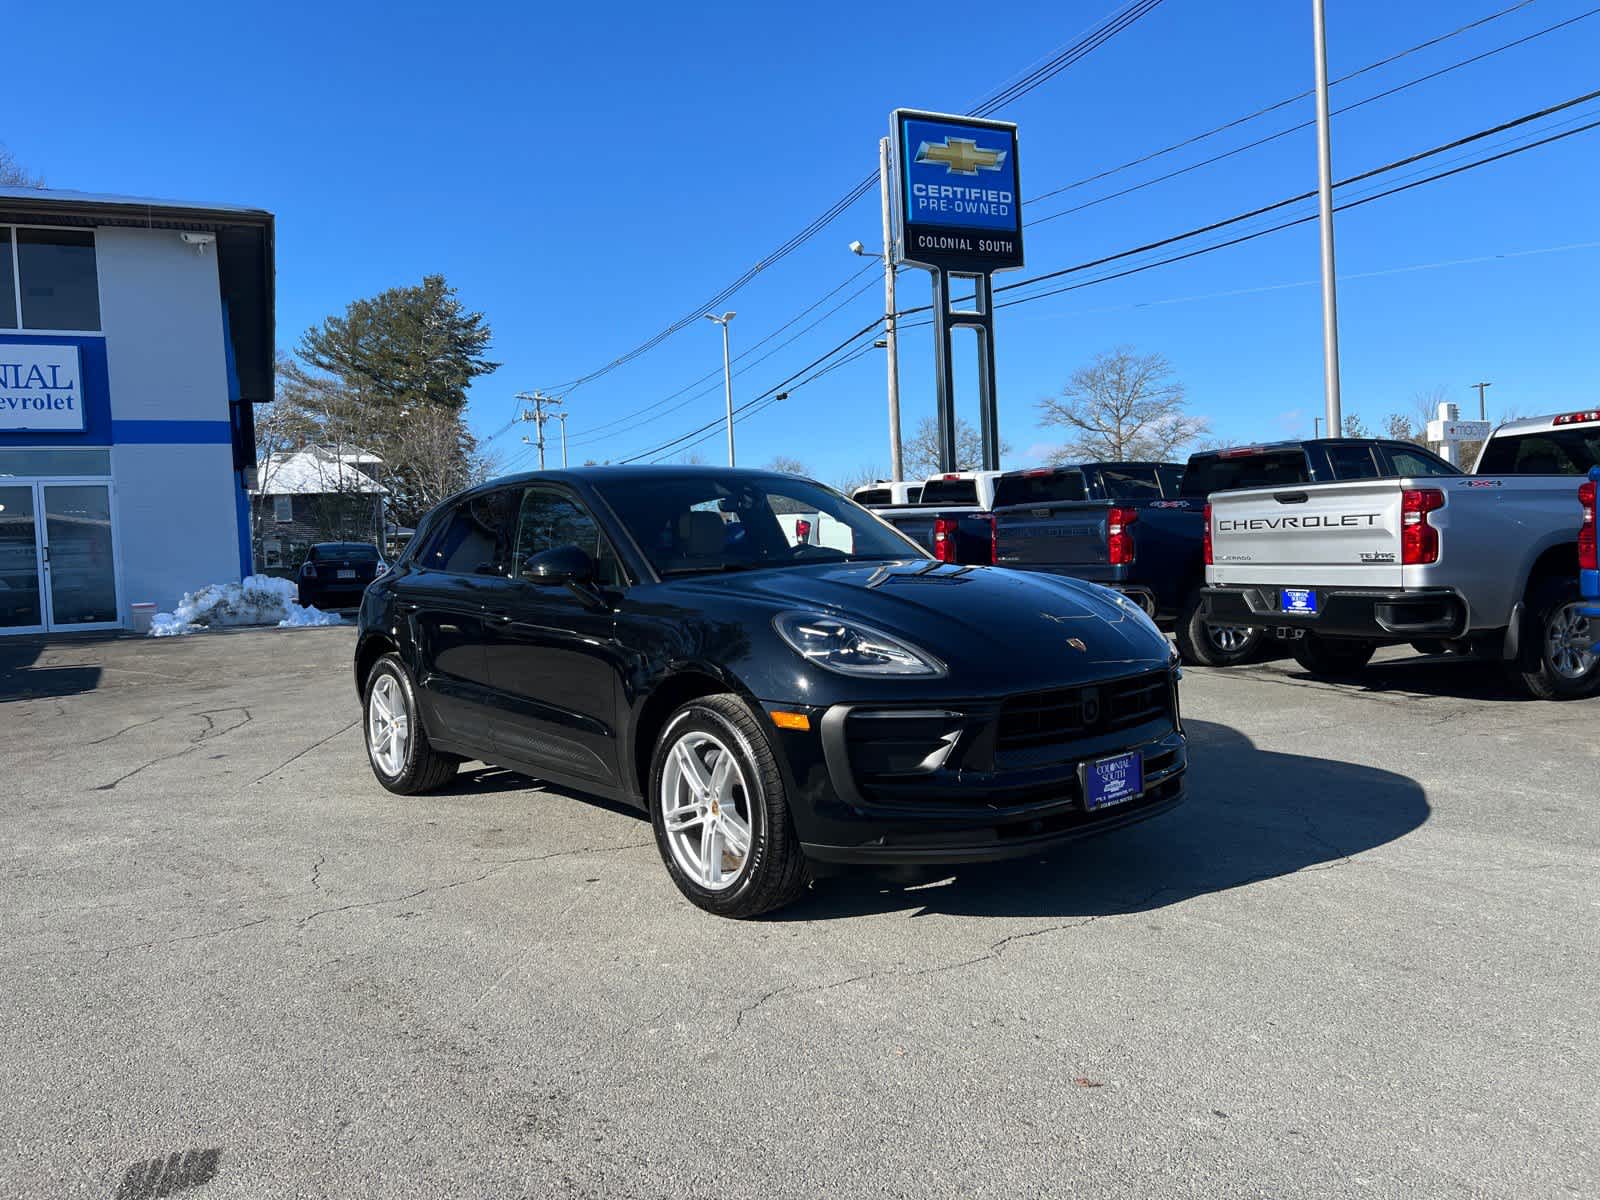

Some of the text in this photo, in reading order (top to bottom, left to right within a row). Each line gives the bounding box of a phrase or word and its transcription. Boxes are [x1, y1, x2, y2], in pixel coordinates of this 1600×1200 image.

[913, 183, 1012, 204] CERTIFIED
[919, 198, 1008, 216] PRE-OWNED
[918, 236, 1013, 253] COLONIAL SOUTH
[1219, 513, 1381, 531] CHEVROLET
